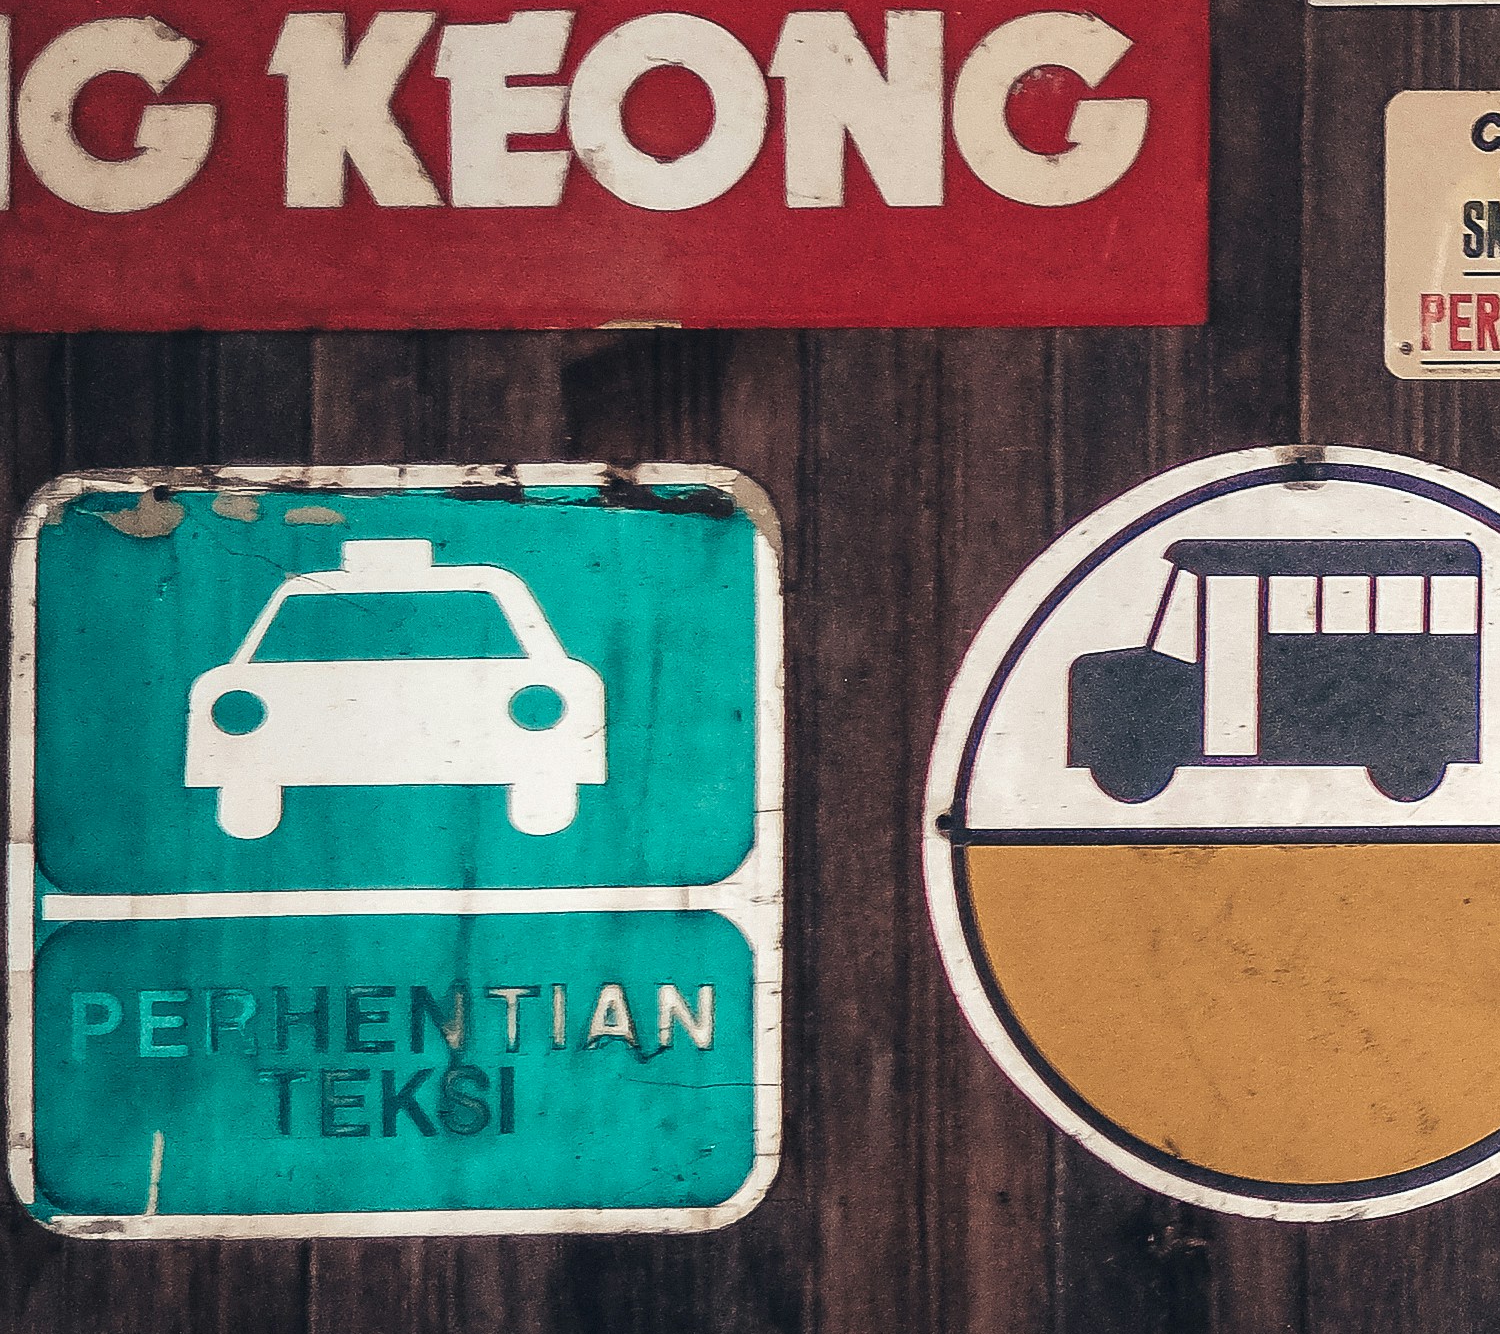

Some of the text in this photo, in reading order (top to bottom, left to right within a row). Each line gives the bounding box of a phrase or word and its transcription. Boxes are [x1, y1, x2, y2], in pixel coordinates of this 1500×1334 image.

[266, 8, 1150, 213] KEONG
[66, 981, 716, 1063] PERHENTIAN
[258, 1064, 517, 1139] TEKSI
